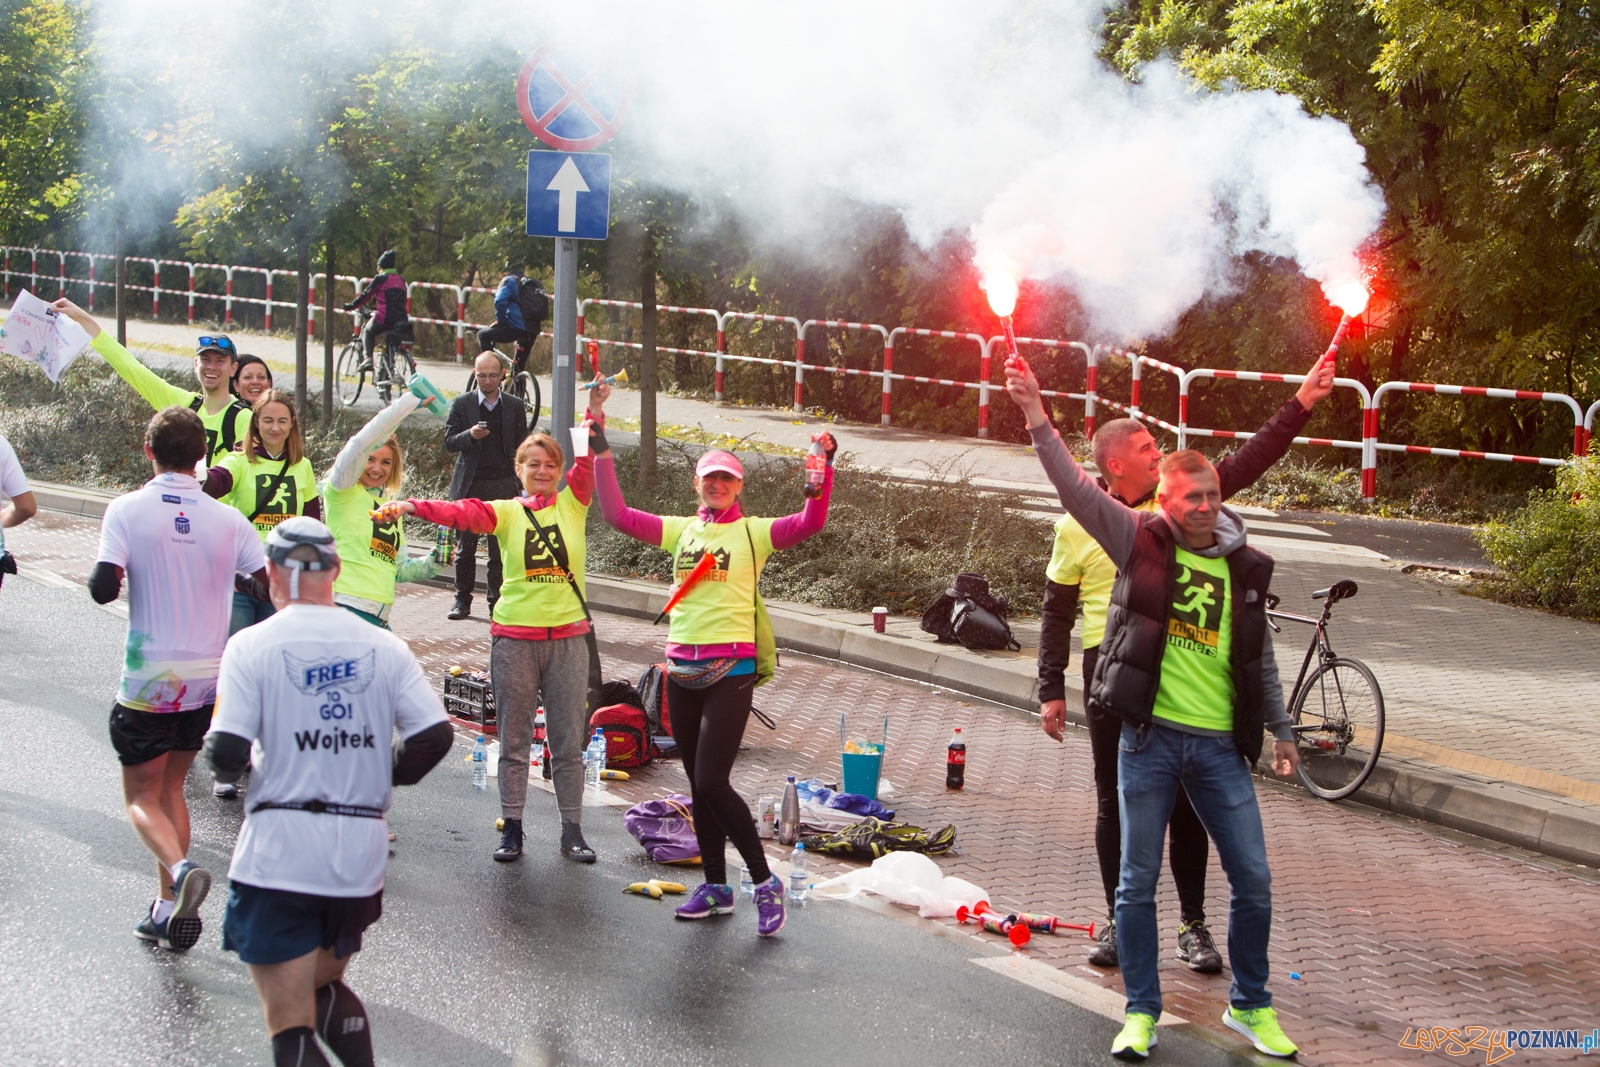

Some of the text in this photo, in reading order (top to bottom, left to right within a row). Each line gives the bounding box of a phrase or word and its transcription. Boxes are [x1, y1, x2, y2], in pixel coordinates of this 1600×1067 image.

[527, 574, 567, 583] runners
[1174, 621, 1209, 642] night
[1166, 634, 1218, 658] unners
[304, 660, 357, 687] FREE
[326, 691, 341, 702] TO
[319, 703, 353, 720] GO!
[294, 725, 375, 755] Wojtek
